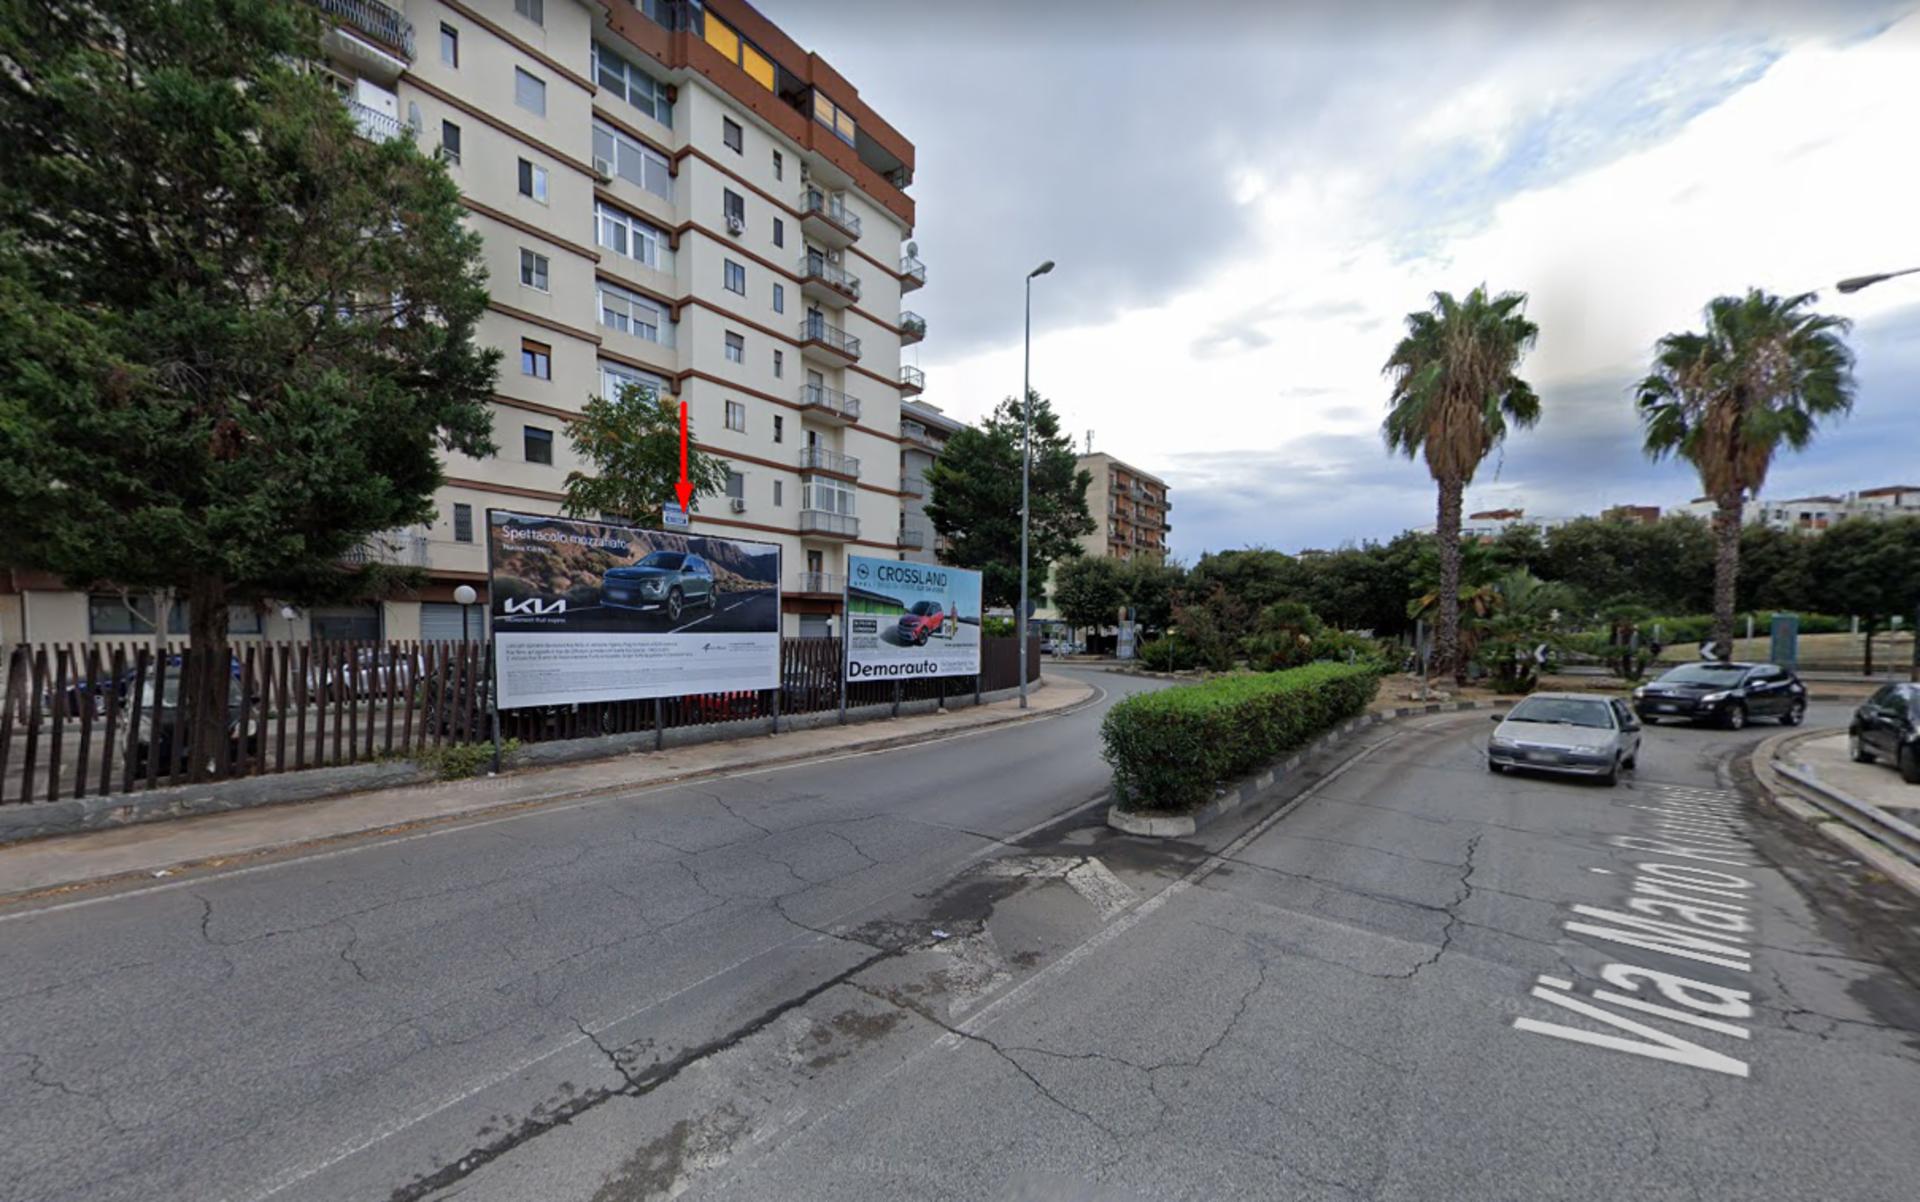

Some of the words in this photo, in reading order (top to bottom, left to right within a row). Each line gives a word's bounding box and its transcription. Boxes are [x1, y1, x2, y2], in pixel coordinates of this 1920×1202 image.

[877, 565, 947, 587] CROSSLAND
[504, 597, 566, 614] KIA
[849, 660, 938, 677] Demarauto
